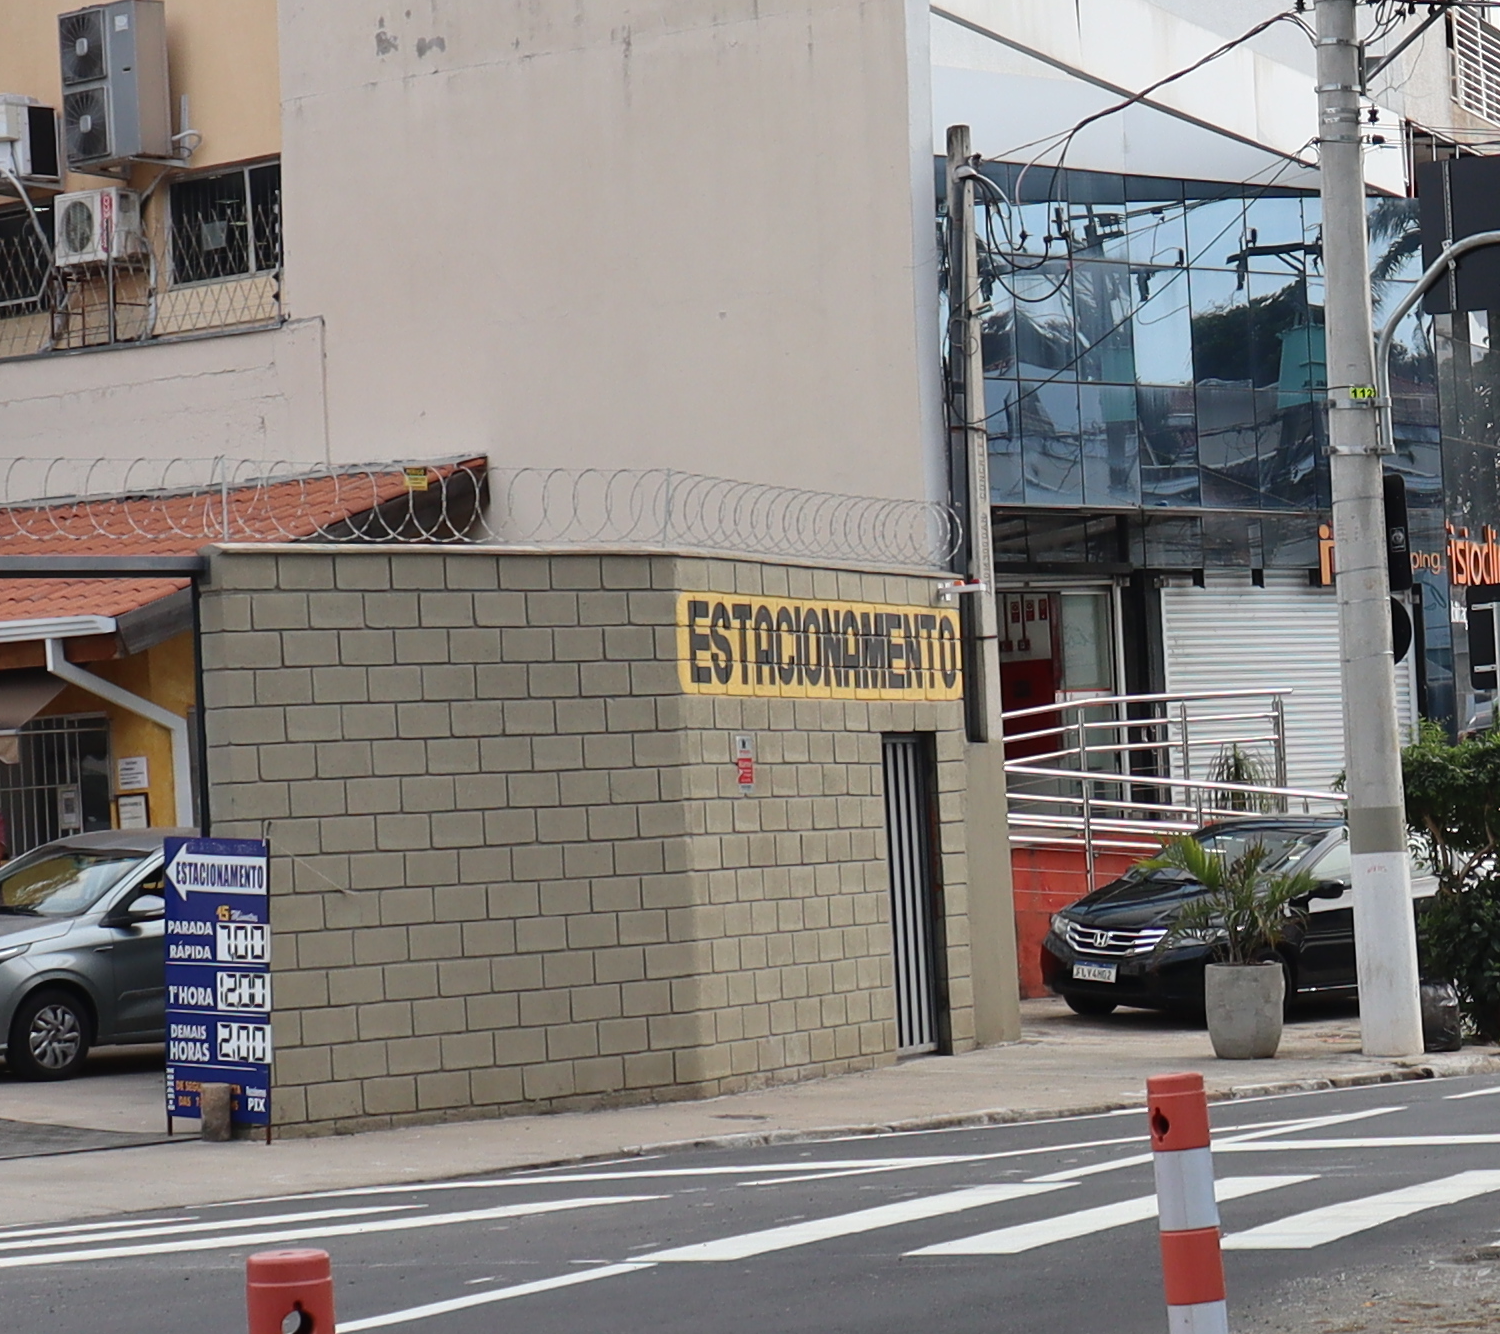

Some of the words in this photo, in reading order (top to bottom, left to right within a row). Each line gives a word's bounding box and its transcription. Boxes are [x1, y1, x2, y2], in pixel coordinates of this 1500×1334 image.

[687, 600, 957, 690] ESTACIONAMENTO
[176, 861, 264, 890] ESTACIONAMENTO
[167, 919, 214, 936] PARADA
[169, 939, 213, 960] RÁPIDA
[178, 986, 215, 1007] HORA
[170, 1023, 207, 1040] DEMAIS
[169, 1041, 210, 1063] HORAS
[247, 1097, 267, 1113] PIX
